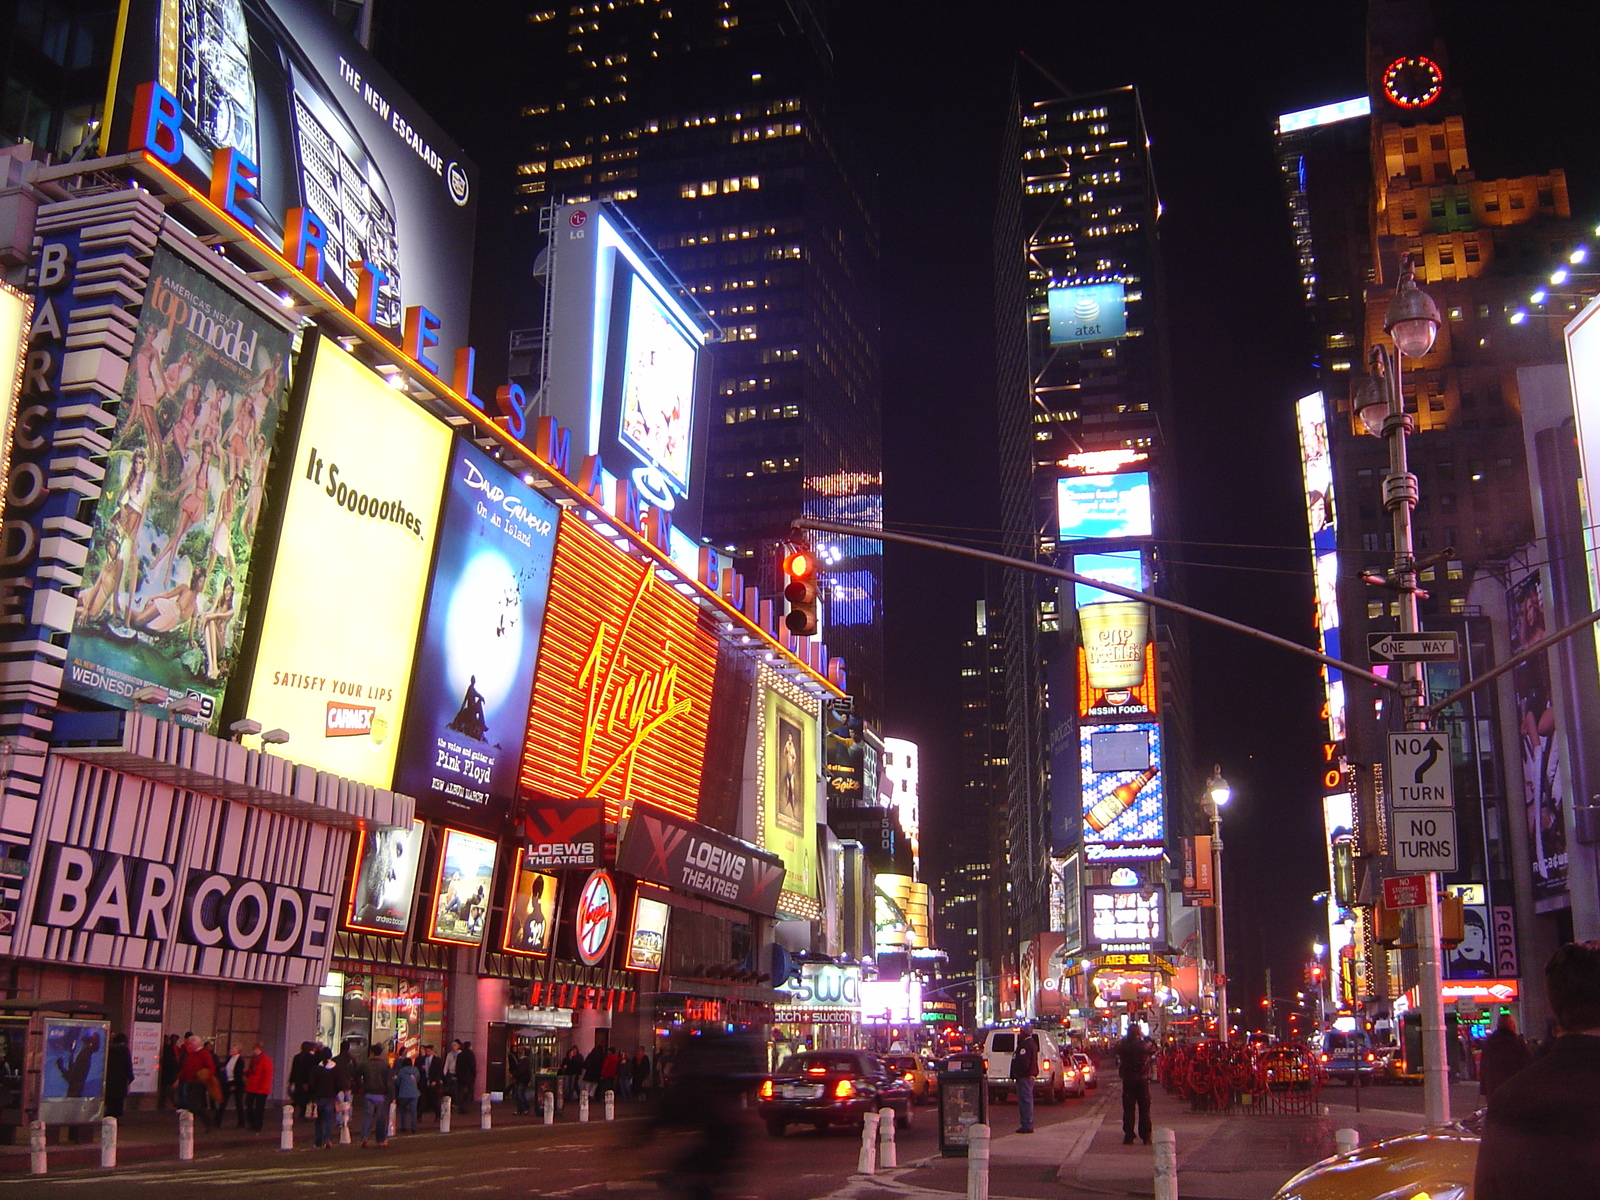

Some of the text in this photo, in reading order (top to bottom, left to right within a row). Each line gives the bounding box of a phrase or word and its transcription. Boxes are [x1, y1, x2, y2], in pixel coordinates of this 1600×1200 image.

[339, 56, 444, 177] THE NEW ESCALADE
[570, 229, 585, 240] LG
[164, 277, 236, 330] AMERICA'S NEXT
[130, 81, 672, 557] BERTELSMANN
[151, 275, 259, 372] top model
[1075, 323, 1102, 337] at&t
[463, 458, 505, 502] DAVID
[305, 446, 425, 542] It Sooooothes.
[476, 500, 488, 519] On
[503, 518, 531, 548] Island
[1380, 641, 1448, 654] ONE WAY
[273, 671, 393, 702] SATISFY YOUR LIPS
[578, 560, 692, 800] Virgin
[327, 707, 376, 729] CARMEX
[1088, 705, 1148, 716] NISSIN FOODS
[437, 737, 447, 748] the
[462, 748, 471, 757] and
[1394, 738, 1422, 756] NO
[435, 749, 491, 784] Pink Floyd
[431, 777, 445, 791] NEW
[444, 782, 465, 798] ALBUM
[465, 788, 484, 804] MARCH
[484, 793, 490, 806] 7
[831, 776, 860, 793] Spike
[1400, 786, 1445, 801] TURN
[1410, 819, 1437, 837] NO
[528, 842, 595, 856] LOEWS
[685, 837, 746, 882] LOEWS
[1084, 844, 1164, 860] Budweiser
[1399, 841, 1451, 859] TURNS
[528, 855, 595, 866] THEATRES
[682, 867, 740, 900] THEATRES
[1399, 878, 1410, 887] NO
[47, 846, 335, 959] BAR CODE
[1101, 942, 1151, 952] Panasonic
[1496, 910, 1514, 971] PEACE
[812, 1011, 850, 1022] swatch
